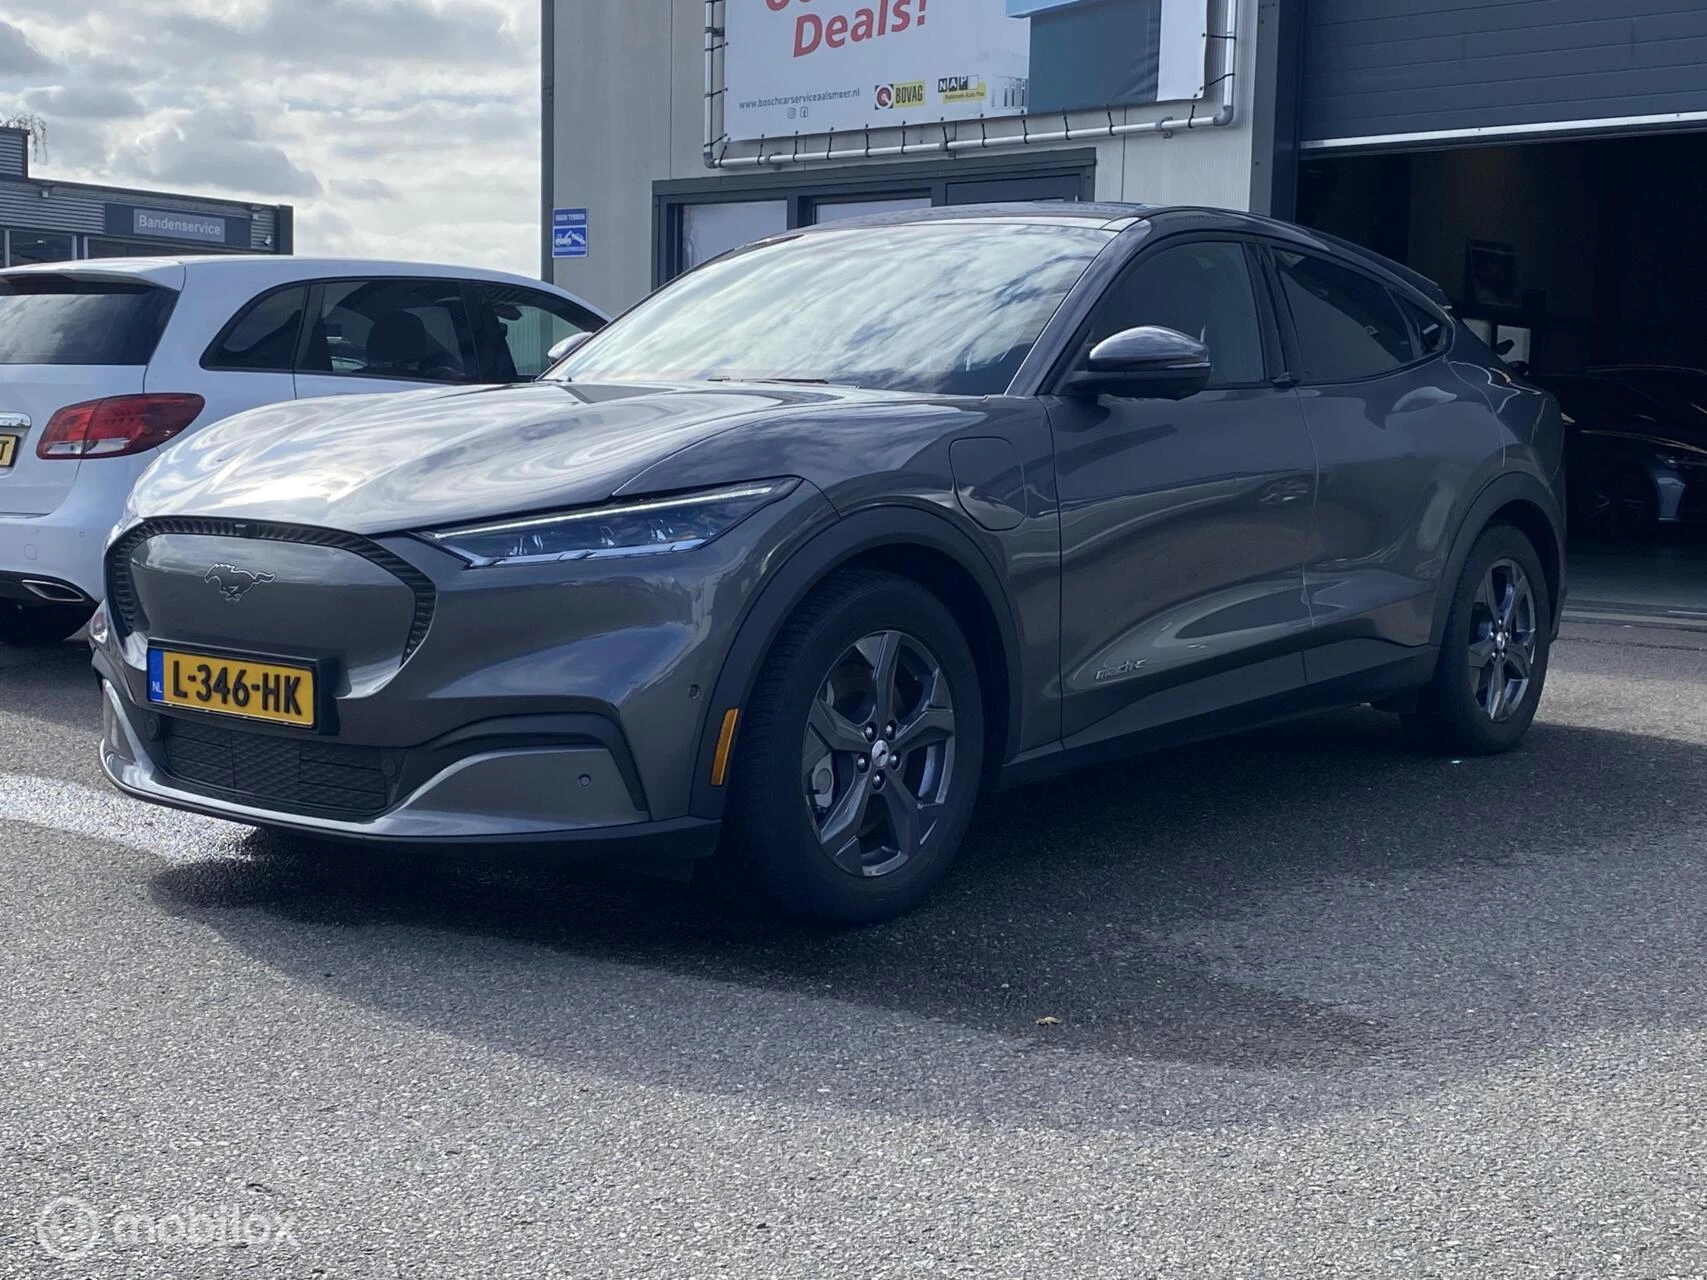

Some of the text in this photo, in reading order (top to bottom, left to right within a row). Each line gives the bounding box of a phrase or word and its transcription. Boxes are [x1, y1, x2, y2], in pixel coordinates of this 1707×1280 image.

[793, 0, 927, 57] Deals!
[739, 88, 860, 108] www.boschcarserviceaalsmeer.nl
[895, 85, 923, 104] BOVAG
[139, 215, 220, 235] Bandenservice
[152, 680, 162, 693] NL
[172, 660, 302, 716] L-346-HK
